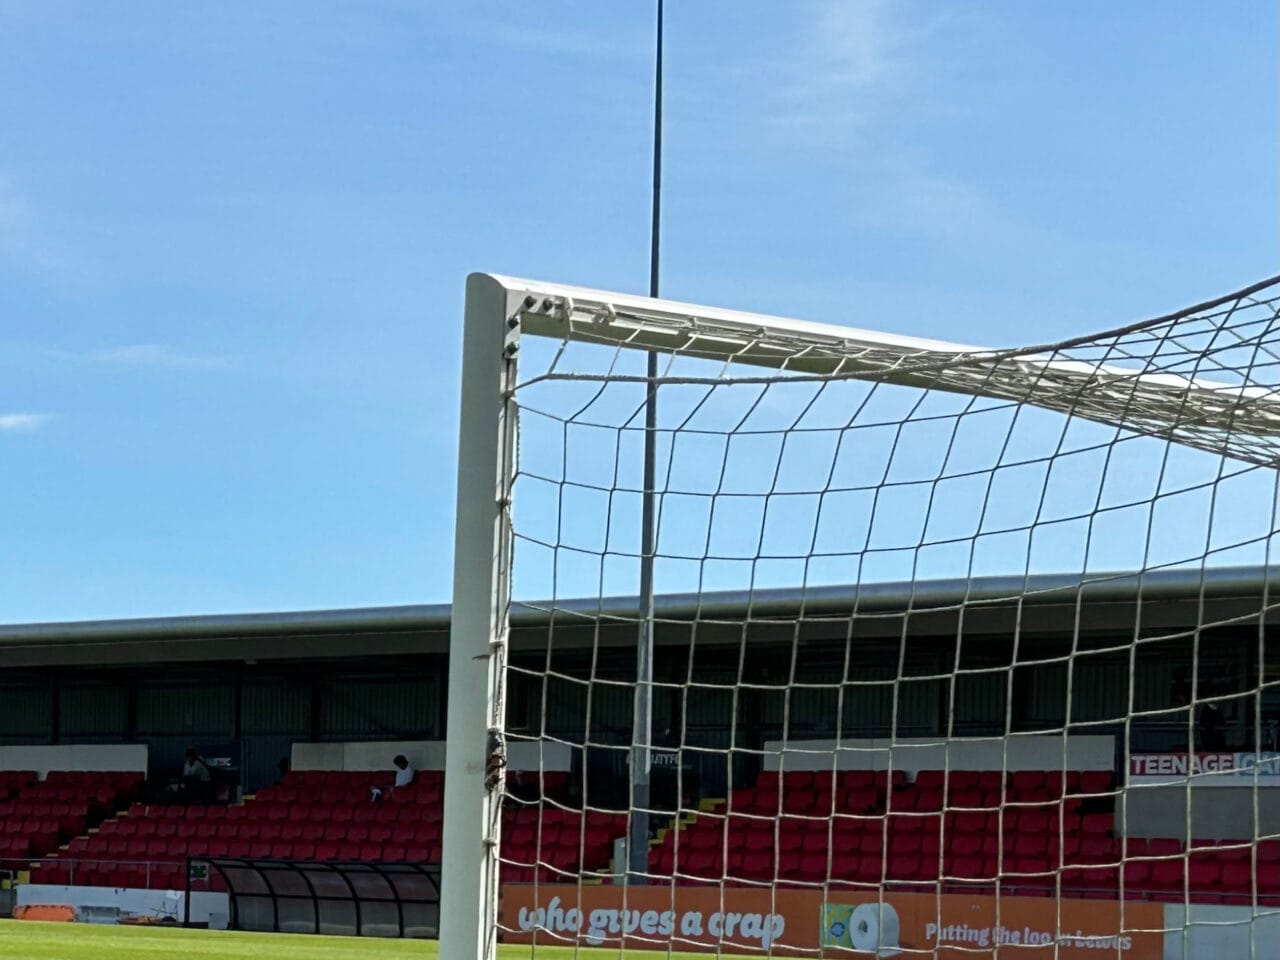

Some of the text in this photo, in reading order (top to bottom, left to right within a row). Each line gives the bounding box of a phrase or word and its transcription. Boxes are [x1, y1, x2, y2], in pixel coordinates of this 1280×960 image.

[1130, 754, 1233, 775] TEENAGE
[518, 896, 786, 950] who gives a crap
[925, 922, 990, 947] Putting
[991, 925, 1021, 945] the
[1024, 926, 1051, 945] loo
